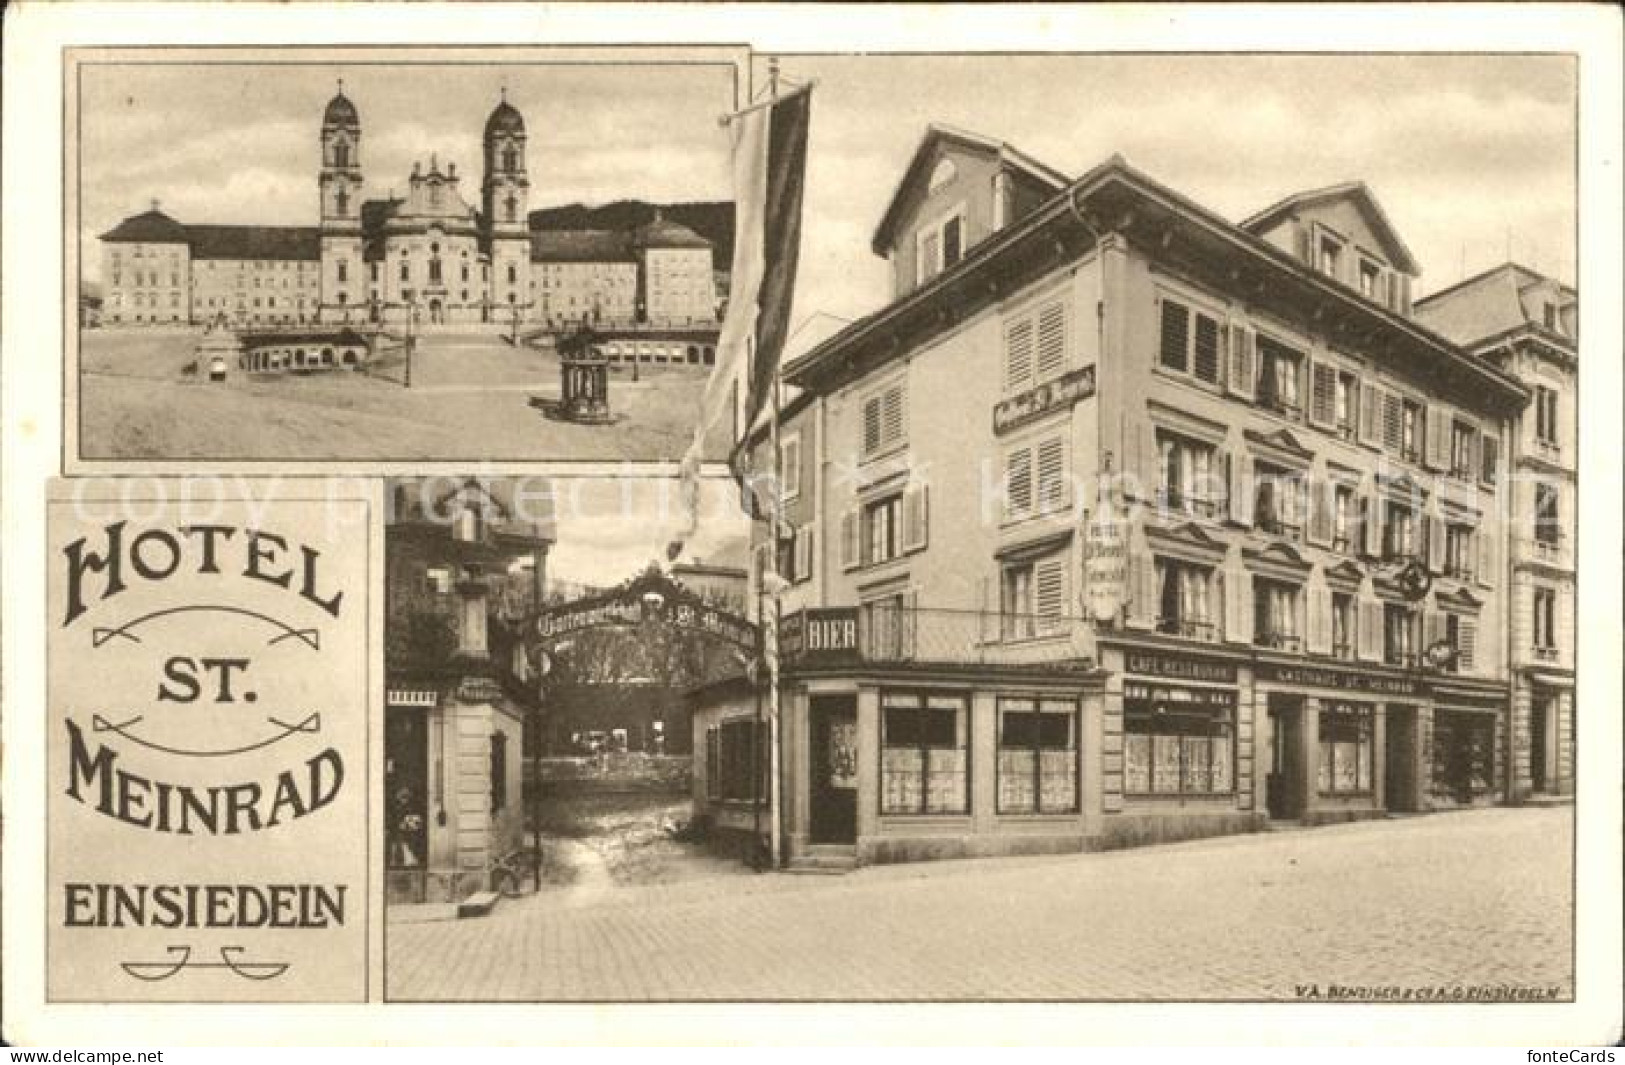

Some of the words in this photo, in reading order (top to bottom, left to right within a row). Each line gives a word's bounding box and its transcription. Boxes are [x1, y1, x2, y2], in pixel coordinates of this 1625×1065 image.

[63, 519, 344, 627] HOTEL
[809, 619, 856, 650] BIER
[158, 656, 258, 703] ST.
[64, 717, 345, 836] MEINRAD
[64, 884, 346, 929] EINSIEDELN
